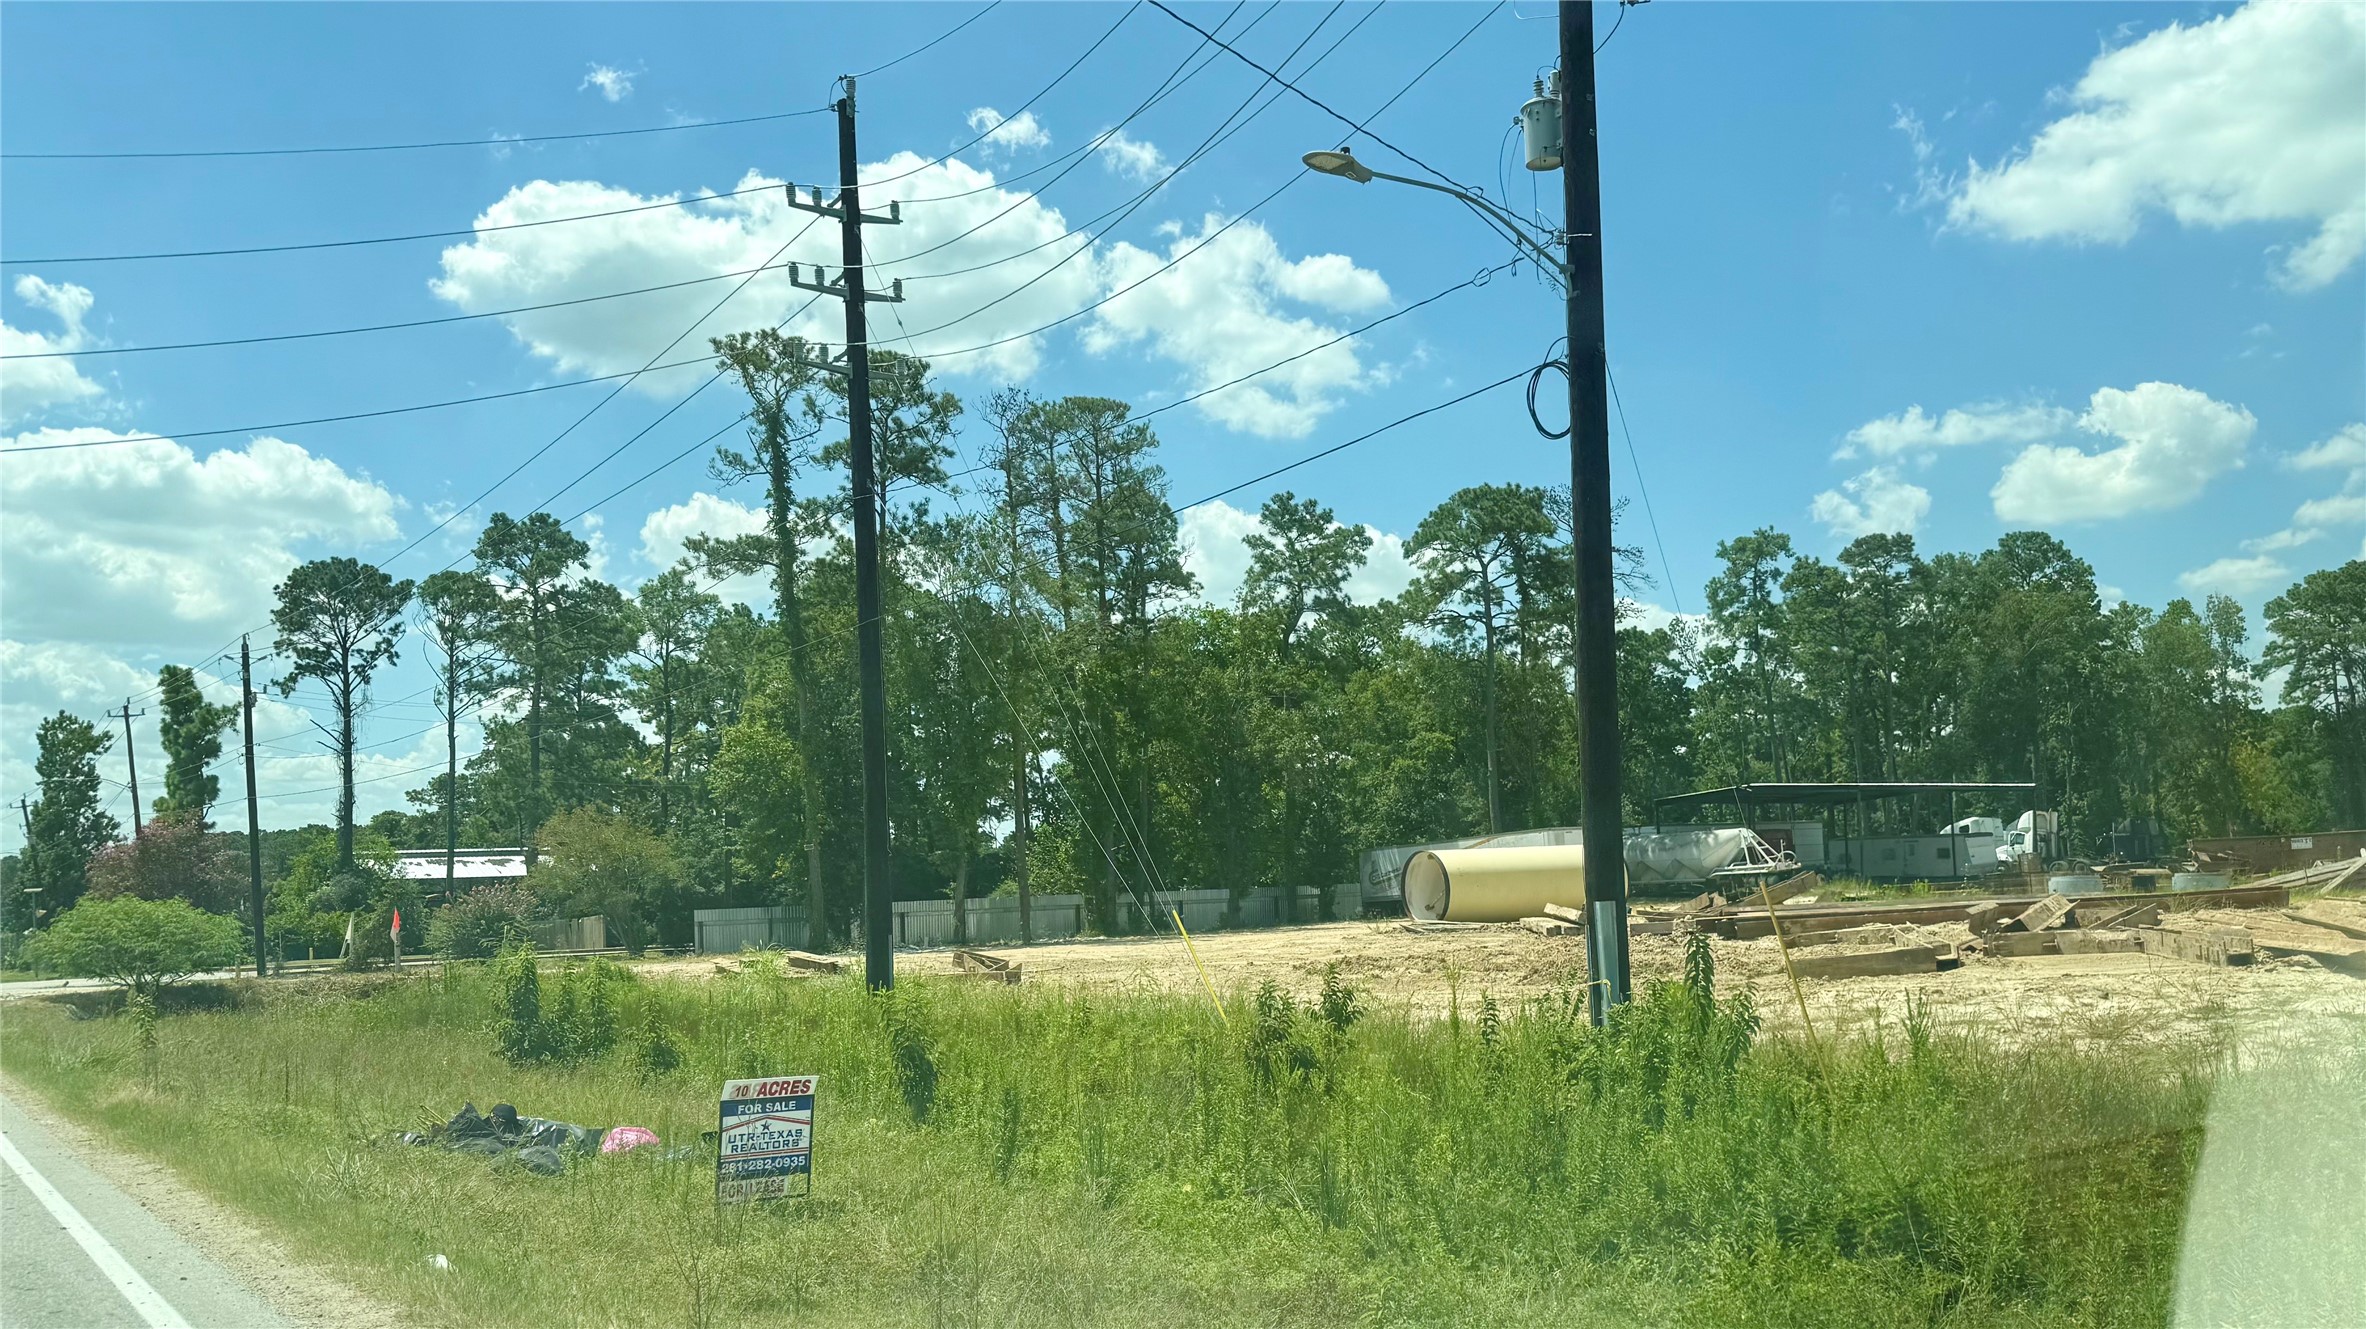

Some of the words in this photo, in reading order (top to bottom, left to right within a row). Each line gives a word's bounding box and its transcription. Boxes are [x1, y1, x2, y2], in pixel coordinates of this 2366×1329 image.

[756, 1079, 812, 1097] ACRES
[737, 1103, 762, 1115] FOR
[766, 1101, 797, 1112] SALE
[728, 1128, 803, 1144] UTR-TEXAS
[731, 1138, 800, 1153] REALTORS
[721, 1156, 806, 1173] 281-282-0935
